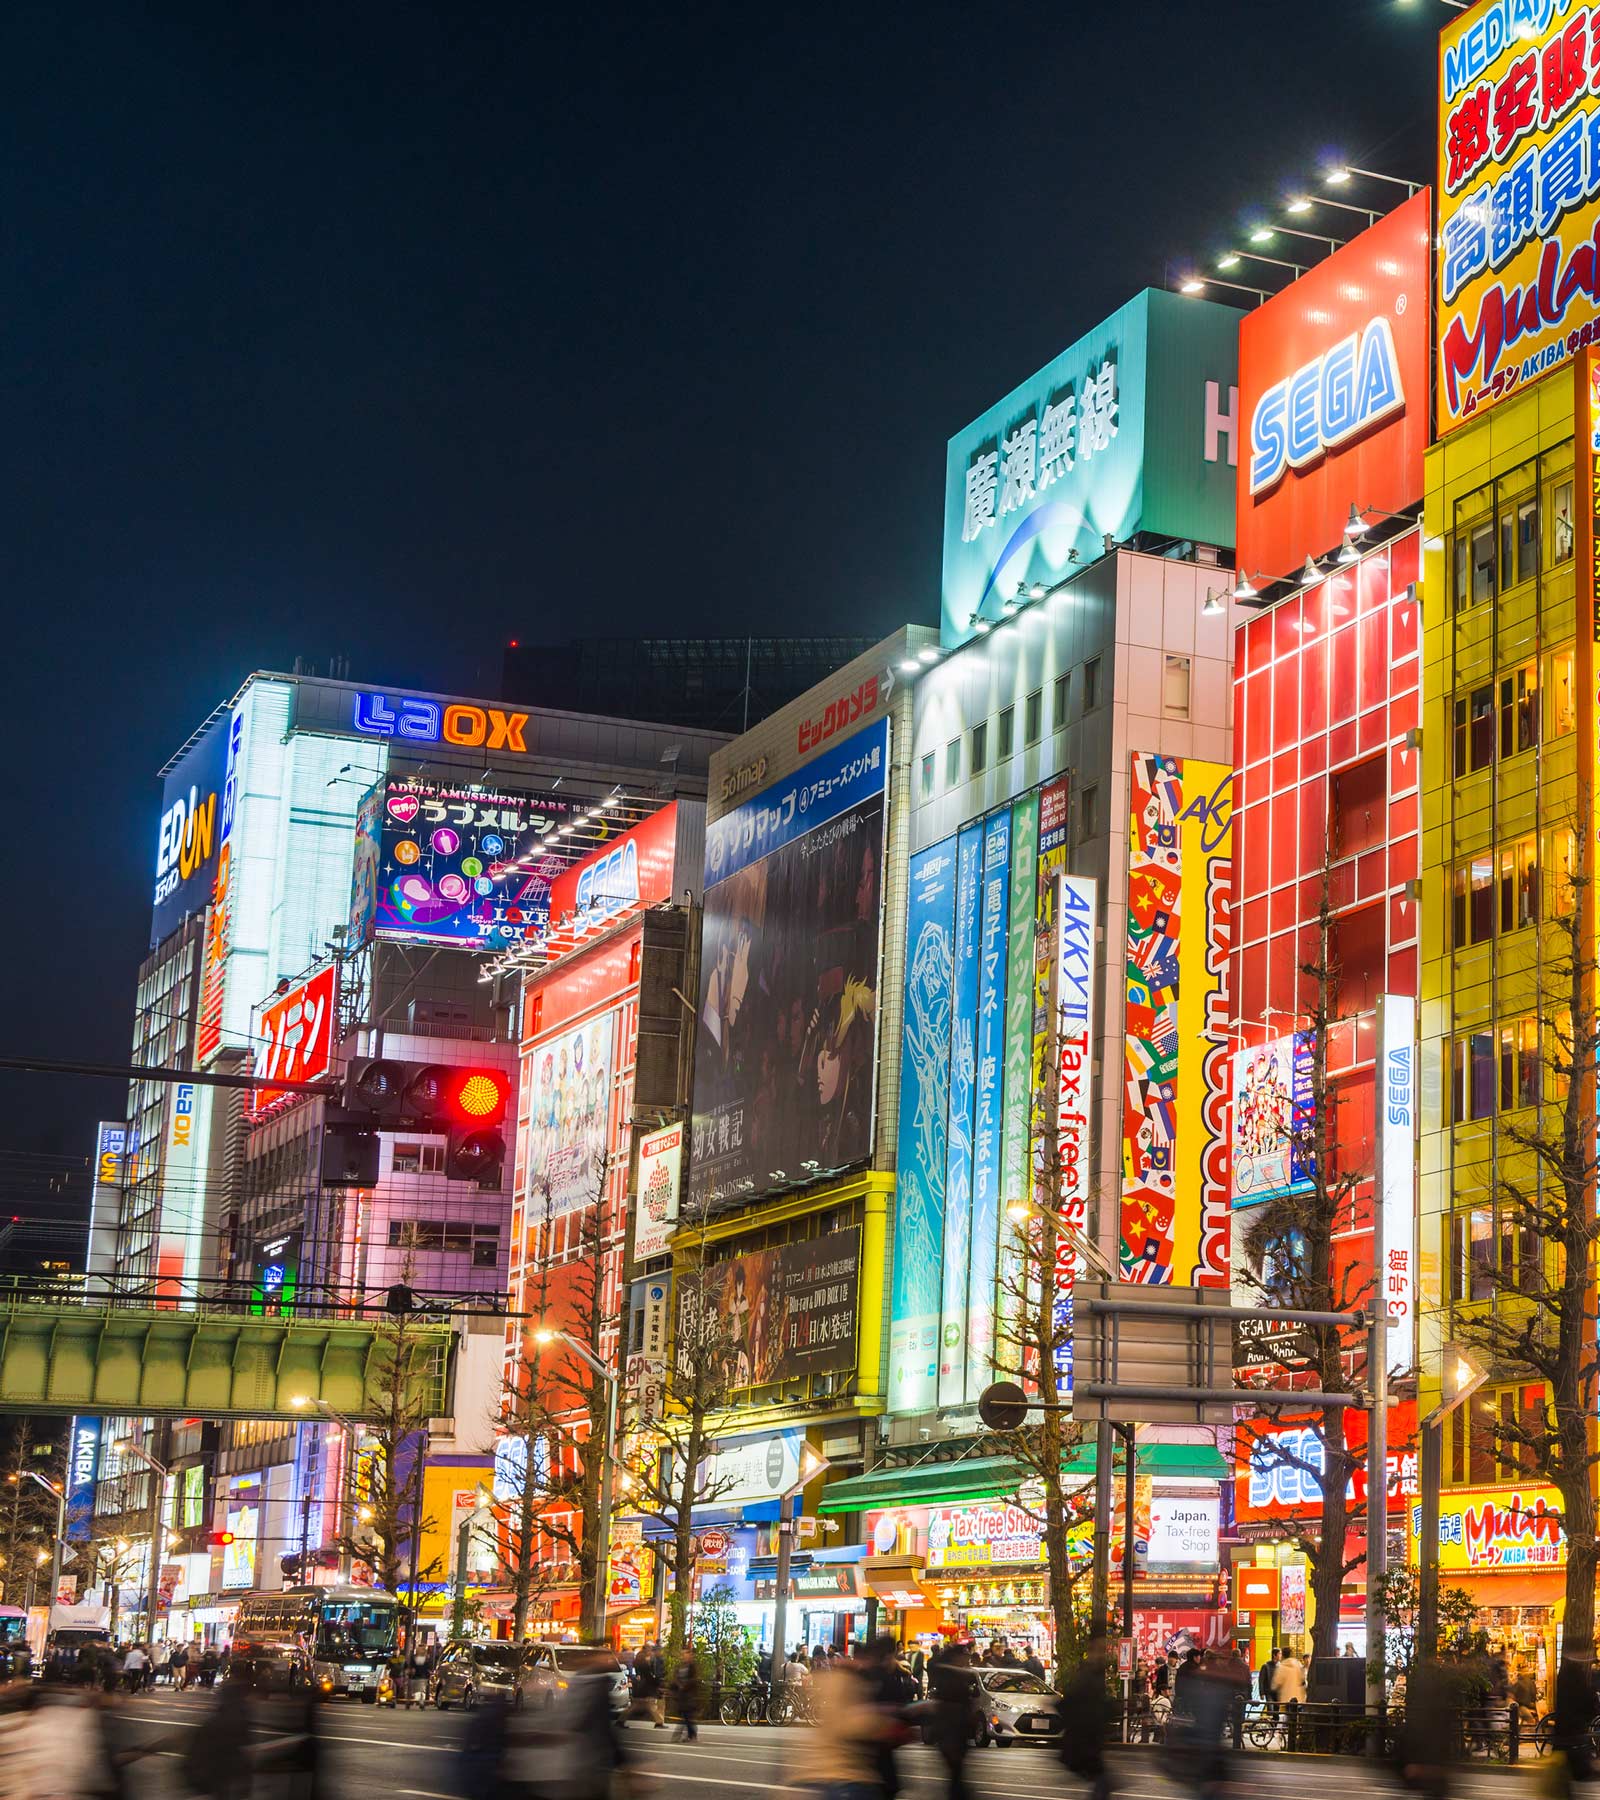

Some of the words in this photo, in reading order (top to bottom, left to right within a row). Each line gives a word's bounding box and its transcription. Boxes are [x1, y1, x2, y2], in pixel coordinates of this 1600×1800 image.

[1250, 316, 1405, 496] SEGA
[1462, 368, 1520, 418] ムーラン
[1520, 345, 1566, 380] AKIBA
[962, 361, 1119, 543] 廣瀬無線
[798, 675, 880, 755] ビックカメラ
[387, 782, 436, 797] ADULT
[439, 788, 527, 806] AMUSEMENT
[530, 799, 568, 812] PARK
[719, 756, 767, 802] Sofmap
[156, 785, 216, 881] EDION
[574, 838, 640, 940] SEGA
[1059, 1030, 1089, 1189] Tax-free
[1387, 1045, 1411, 1127] SEGA
[100, 1129, 126, 1183] EDION
[692, 1110, 744, 1163] 幼女戦記
[1387, 1248, 1411, 1318] 3号館
[73, 1428, 97, 1487] AKIBA
[1165, 1524, 1211, 1538] Tax-free
[1170, 1509, 1211, 1524] Japan.
[1181, 1538, 1211, 1553] Shop
[1503, 1549, 1526, 1564] AKIBA
